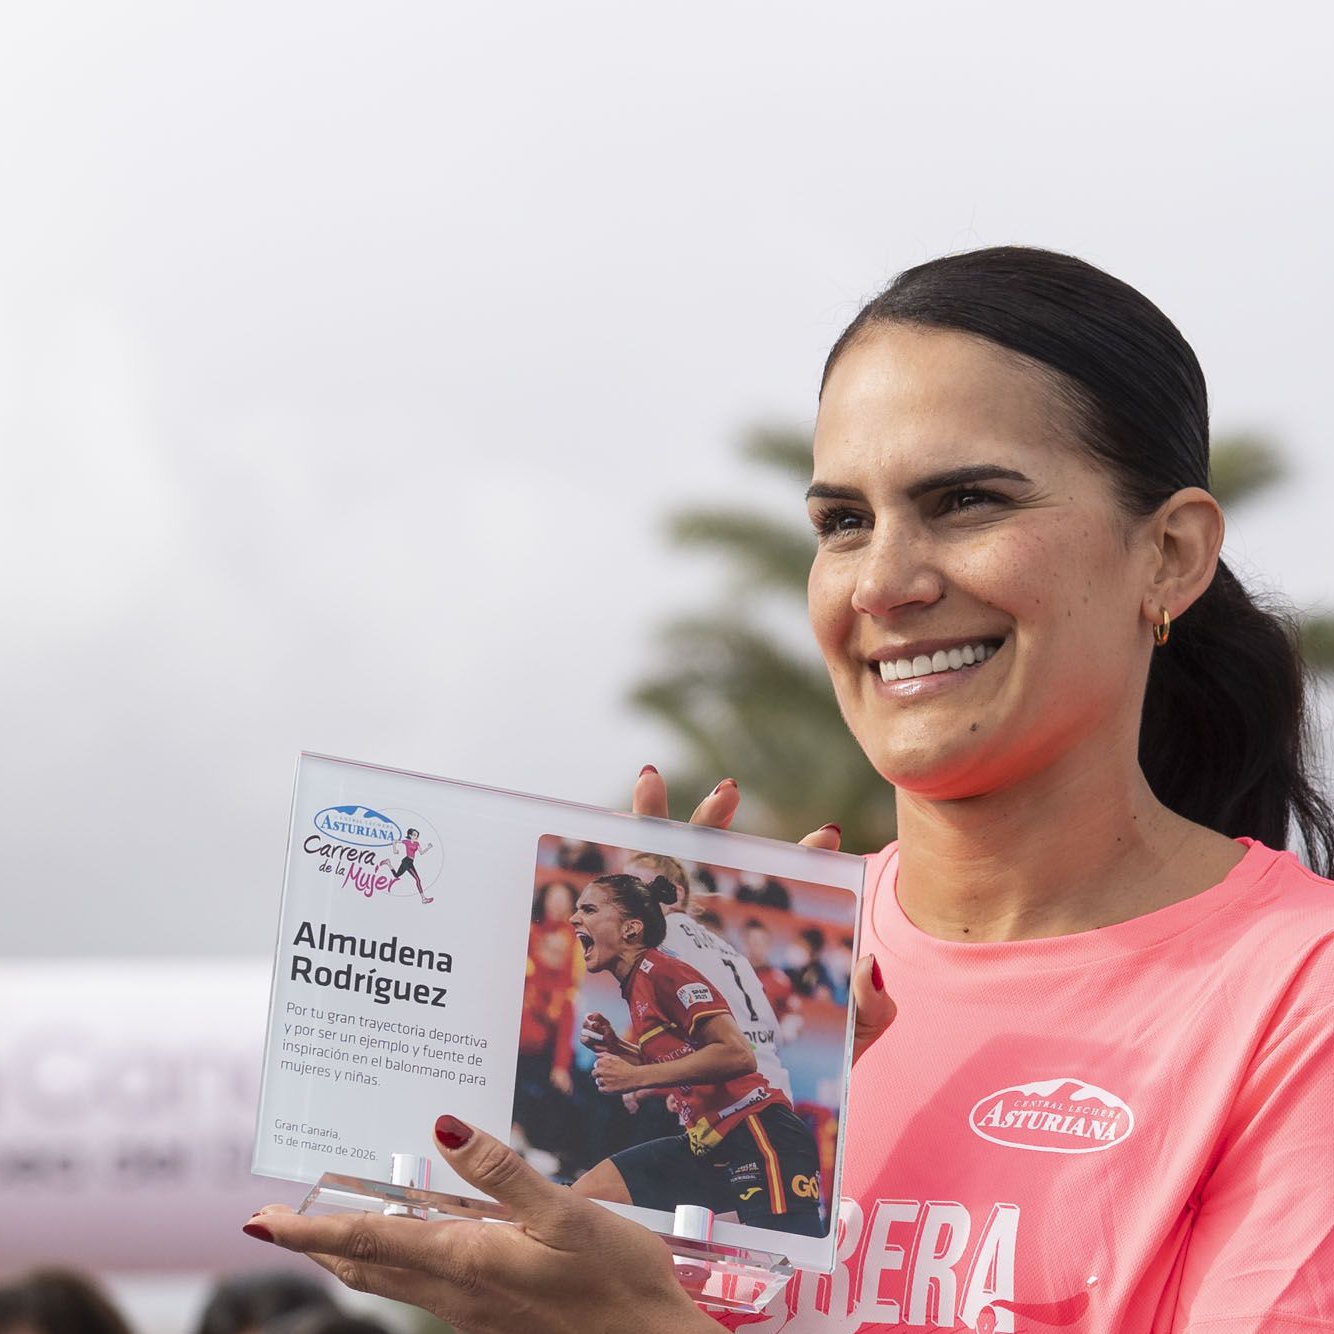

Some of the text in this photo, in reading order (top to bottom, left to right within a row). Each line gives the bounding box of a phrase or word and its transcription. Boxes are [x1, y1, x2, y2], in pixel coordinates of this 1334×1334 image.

[321, 814, 394, 841] ASTURIANA
[303, 835, 376, 866] Carrera
[319, 859, 400, 898] de la Mujer
[293, 921, 453, 973] Almudena
[291, 955, 447, 1008] Rodríguez
[287, 1001, 488, 1049] Por tu gran trayectoria deportiva
[282, 1039, 486, 1086] inspiración en el balonmano para
[284, 1023, 483, 1067] y por ser un ejemplo y fuente de
[280, 1060, 381, 1087] mujeres y niñas.
[977, 1099, 1116, 1140] ASTURIANA
[1013, 1099, 1122, 1120] CENTRAL LECHERA
[273, 1134, 379, 1161] 15 de marzo de 2026.
[275, 1119, 341, 1140] Gran Canaria,
